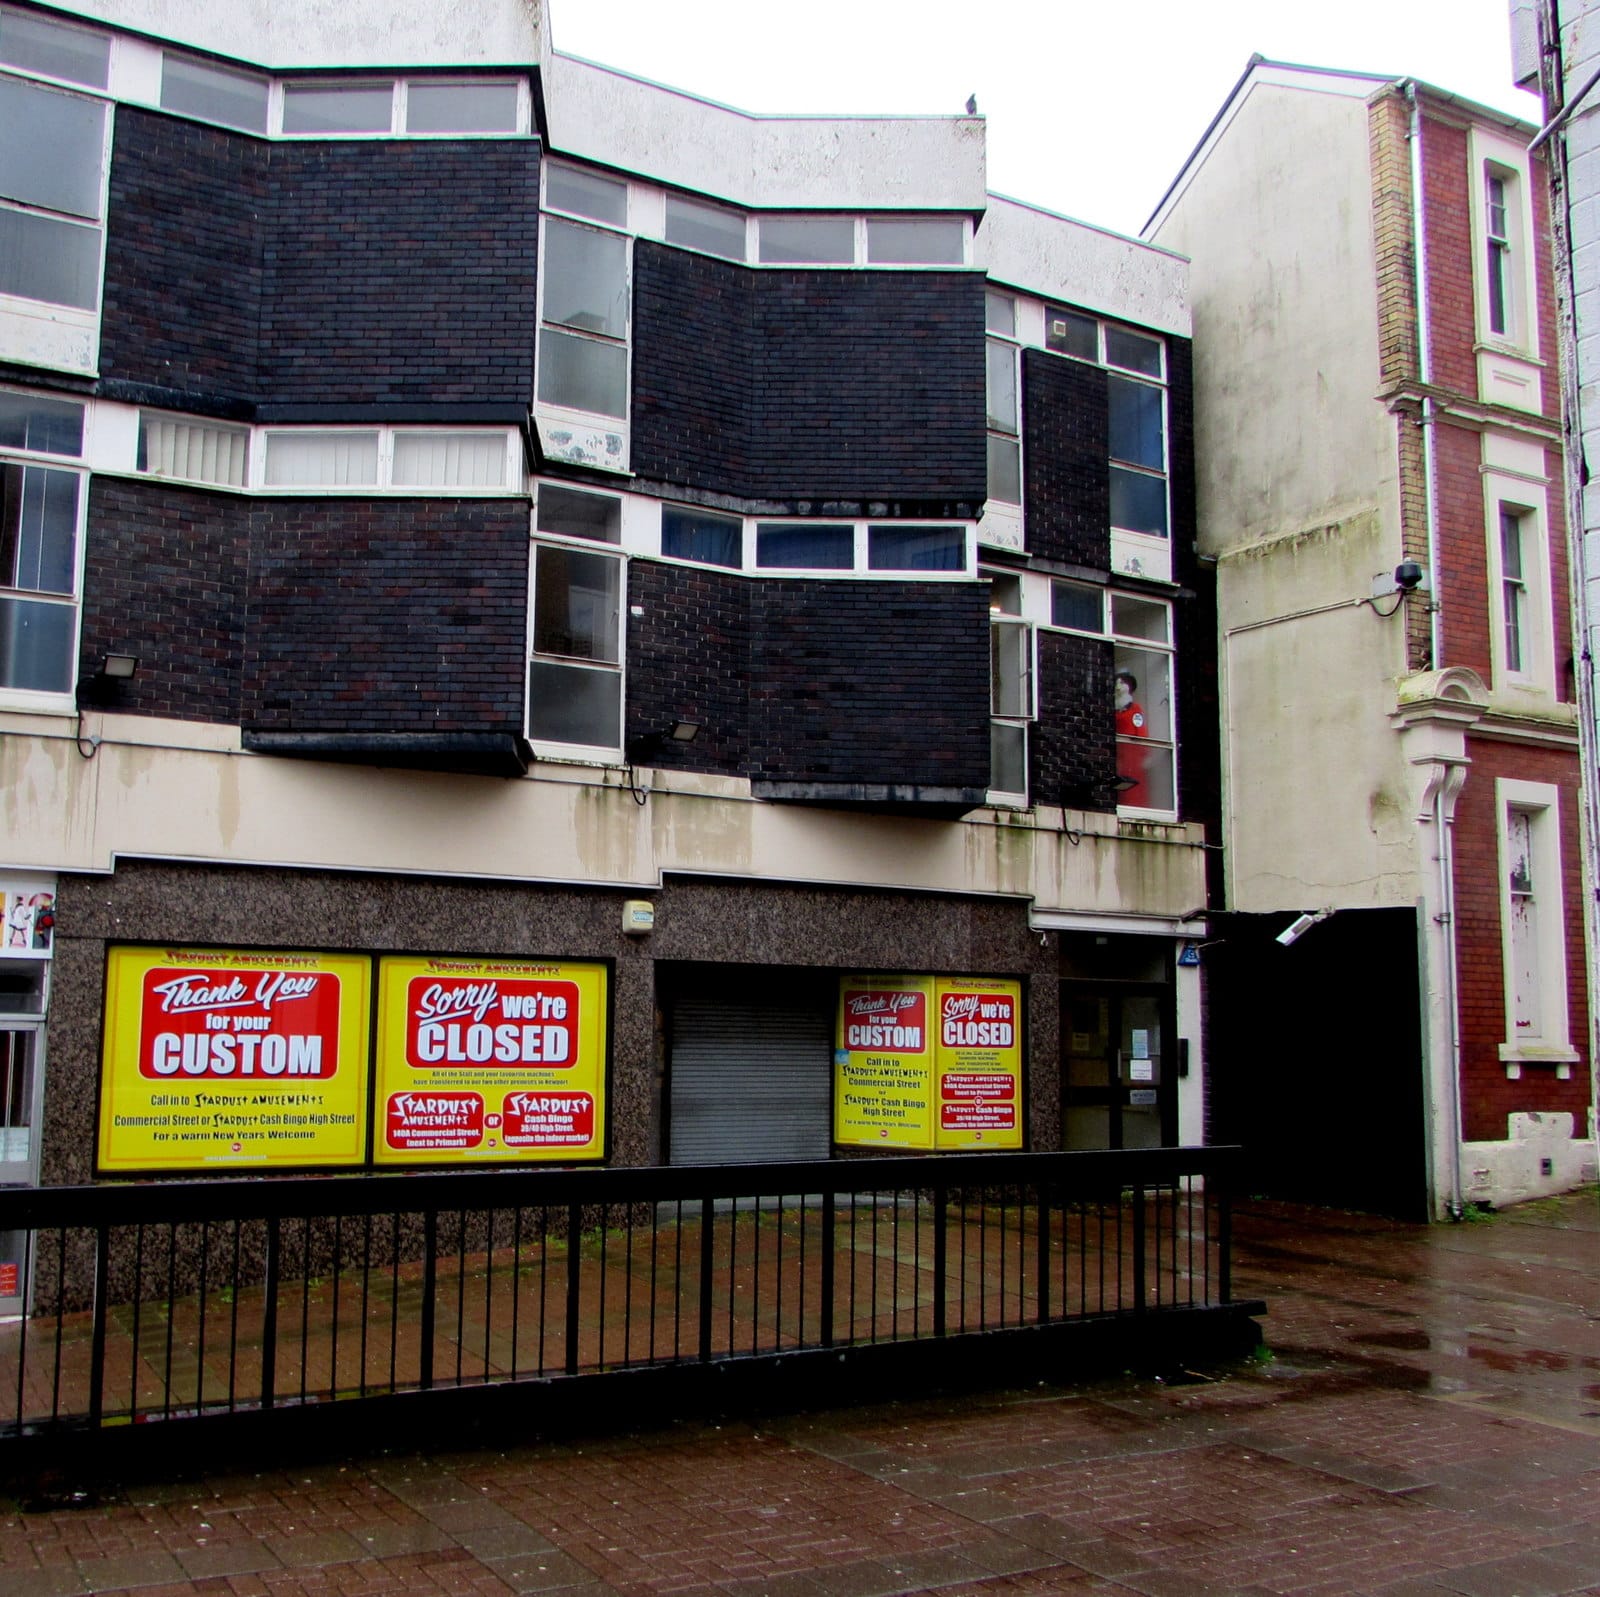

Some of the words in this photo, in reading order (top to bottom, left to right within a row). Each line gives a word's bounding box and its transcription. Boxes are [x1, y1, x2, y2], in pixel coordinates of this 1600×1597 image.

[153, 975, 248, 1012] Thank
[255, 972, 318, 1010] You
[415, 981, 498, 1023] Sorry
[502, 992, 567, 1019] we're
[848, 995, 886, 1015] Thank
[890, 993, 918, 1013] You
[942, 995, 979, 1021] Sorry
[981, 1001, 1010, 1019] we're
[206, 1014, 230, 1030] for
[233, 1016, 271, 1031] your
[869, 1015, 879, 1024] for
[880, 1016, 897, 1025] your
[849, 1025, 920, 1048] CUSTOM
[944, 1021, 1012, 1046] CLOSED
[418, 1023, 569, 1062] CLOSED
[153, 1033, 322, 1075] CUSTOM
[867, 1058, 881, 1066] Call
[883, 1058, 890, 1066] in
[848, 1078, 895, 1087] Commercial
[897, 1079, 920, 1088] Street
[151, 1095, 168, 1106] Call
[171, 1095, 179, 1105] in
[181, 1096, 190, 1105] to
[390, 1093, 480, 1118] STARDUST
[506, 1093, 591, 1116] STARDUST
[881, 1098, 900, 1106] Cash
[903, 1099, 925, 1108] Bingo
[863, 1107, 880, 1116] High
[882, 1108, 905, 1117] Street
[115, 1115, 170, 1126] Commercial
[172, 1114, 199, 1126] Street
[201, 1116, 210, 1125] or
[260, 1114, 281, 1125] Cash
[283, 1113, 307, 1125] Bingo
[309, 1113, 328, 1125] High
[330, 1113, 355, 1124] Street
[402, 1115, 468, 1125] AMUSEMENTS
[488, 1117, 499, 1125] or
[525, 1115, 546, 1123] Cash
[548, 1115, 573, 1124] Bingo
[153, 1132, 169, 1140] For
[213, 1132, 234, 1140] New
[237, 1131, 265, 1139] Years
[267, 1131, 316, 1139] Welcome
[412, 1129, 456, 1137] Commercial
